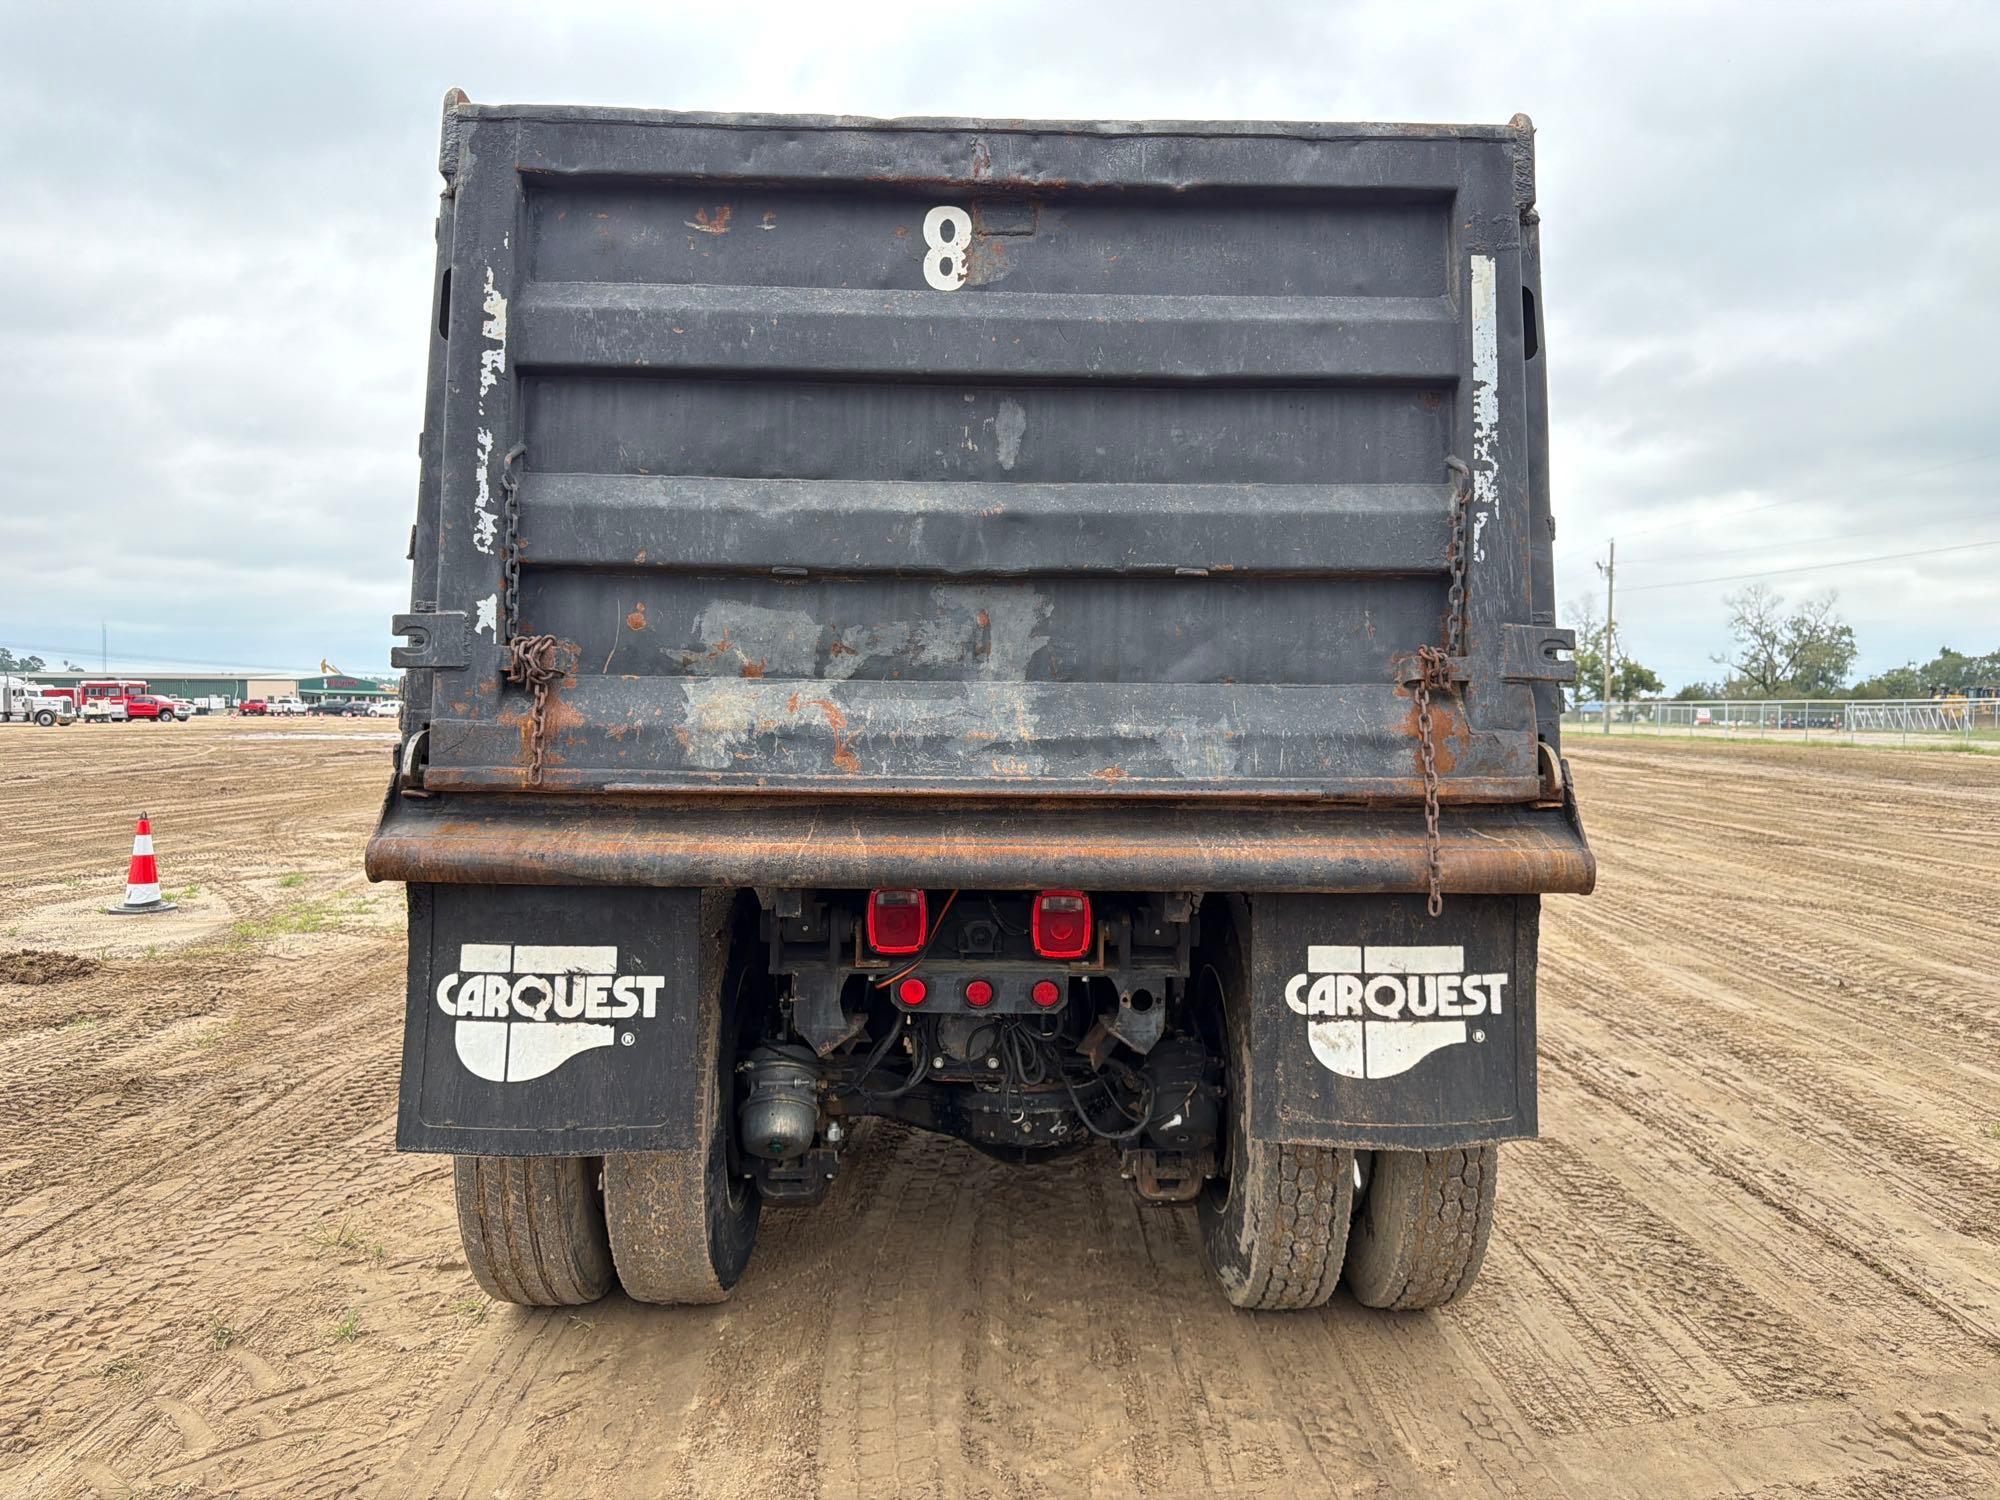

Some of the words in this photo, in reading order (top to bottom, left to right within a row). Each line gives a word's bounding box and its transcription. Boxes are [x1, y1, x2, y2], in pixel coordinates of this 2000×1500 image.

[923, 205, 972, 291] 8
[436, 973, 665, 1021] CARQUEST
[1284, 973, 1508, 1019] CARQUEST
